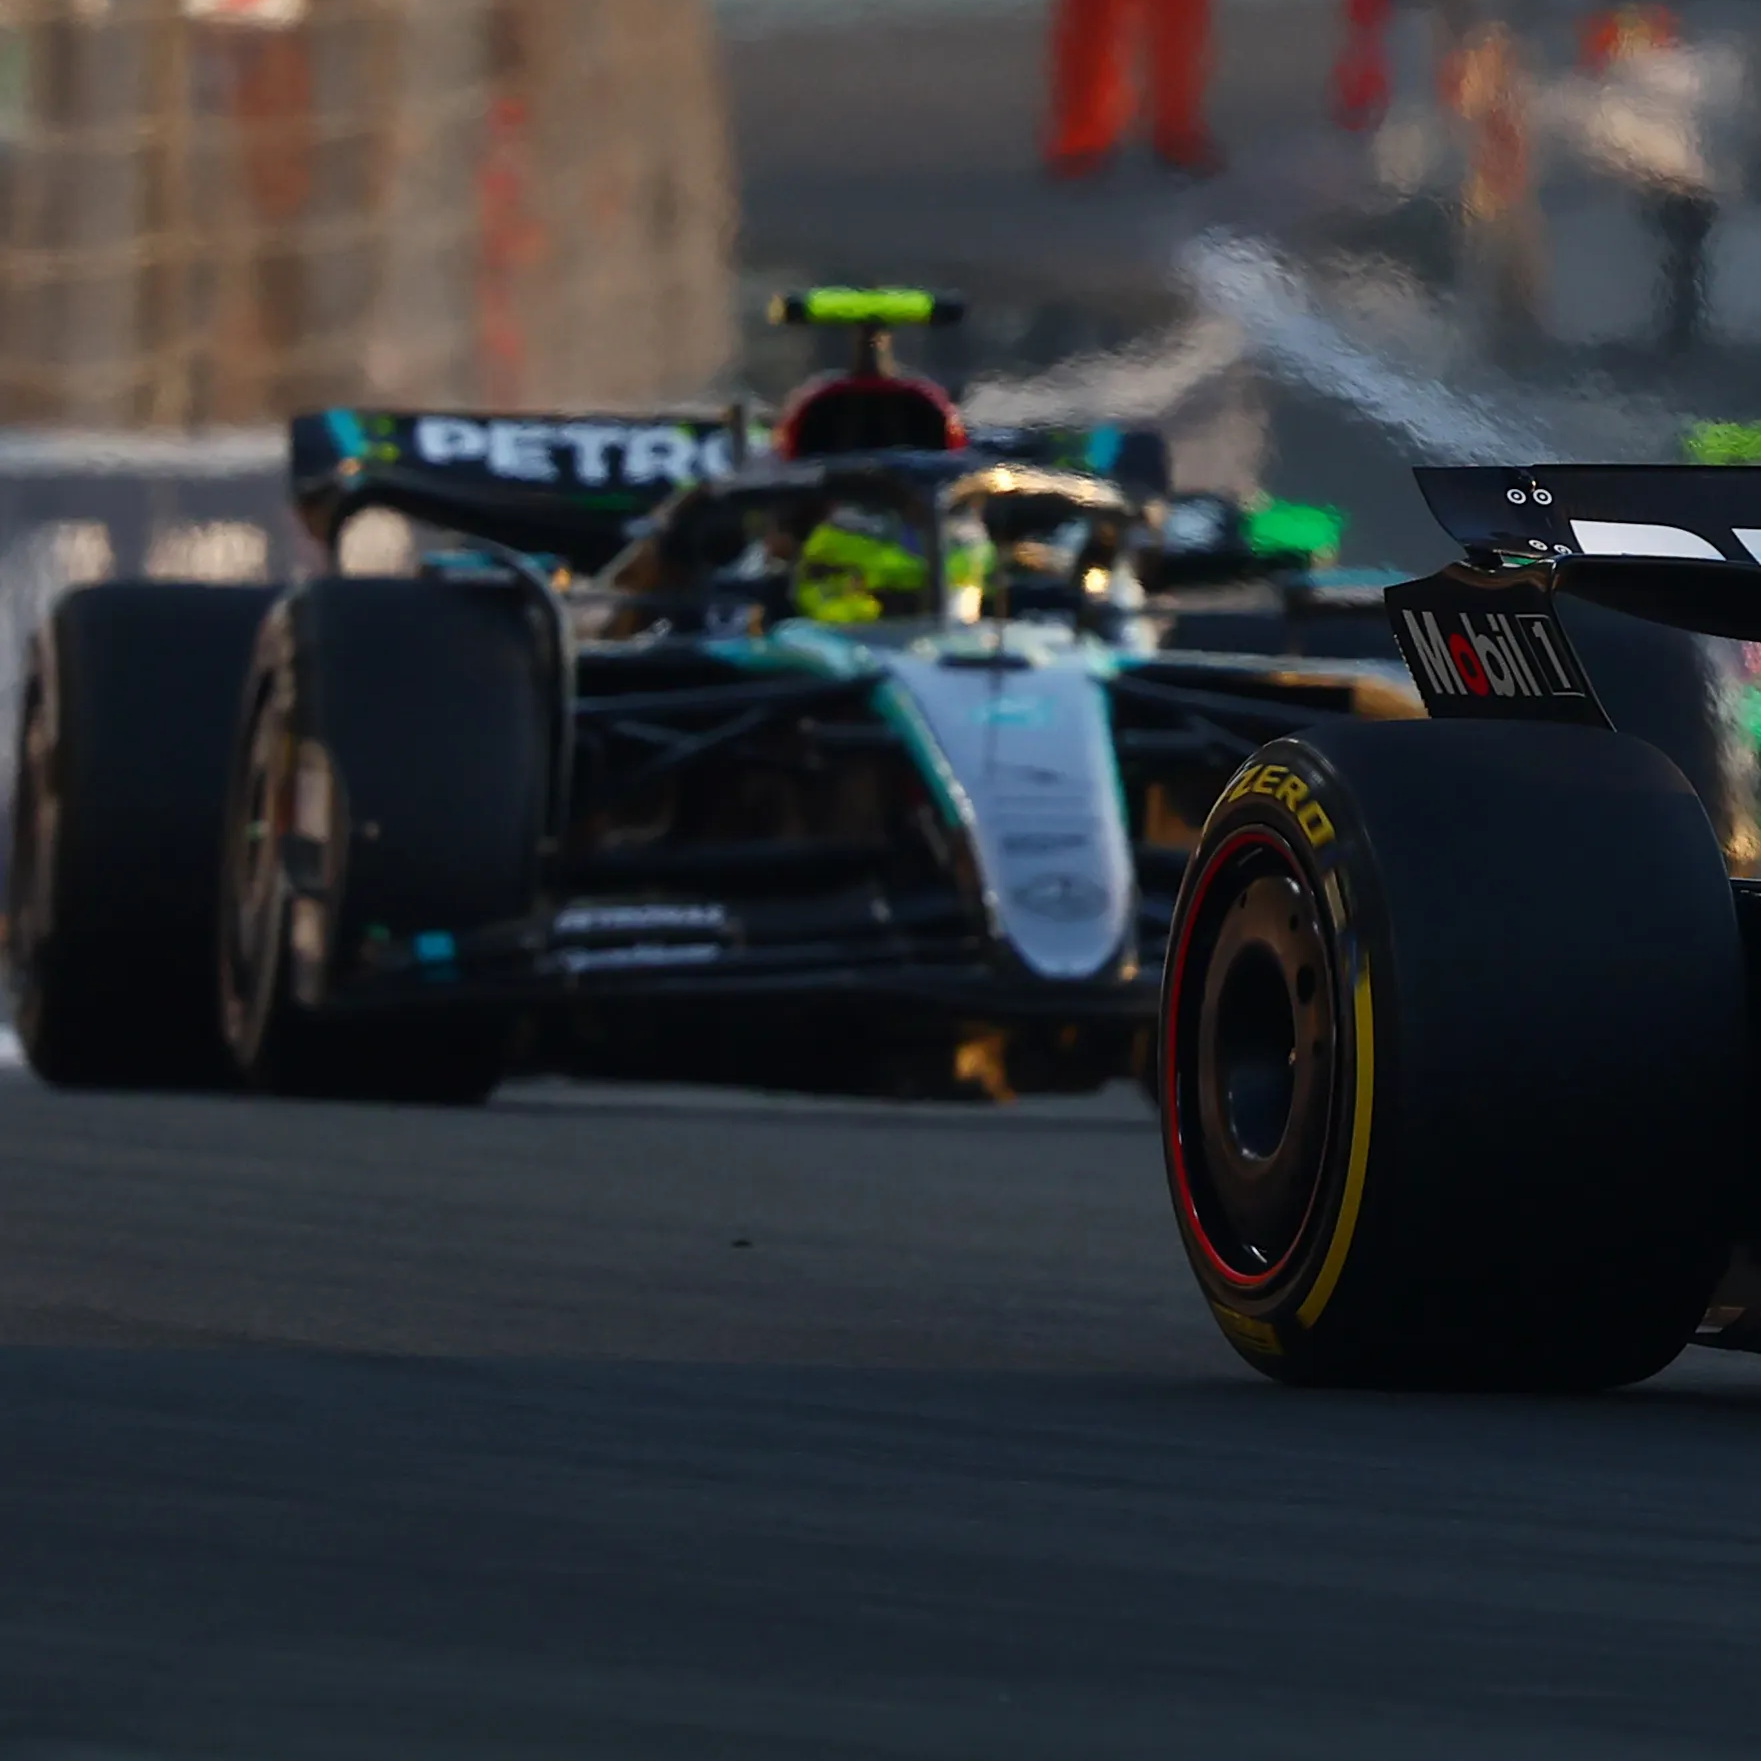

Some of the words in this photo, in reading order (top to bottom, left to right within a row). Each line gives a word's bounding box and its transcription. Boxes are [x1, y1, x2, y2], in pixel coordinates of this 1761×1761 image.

[1402, 608, 1543, 697] Mobil
[1532, 621, 1571, 689] 1
[1226, 763, 1337, 850] ZERO
